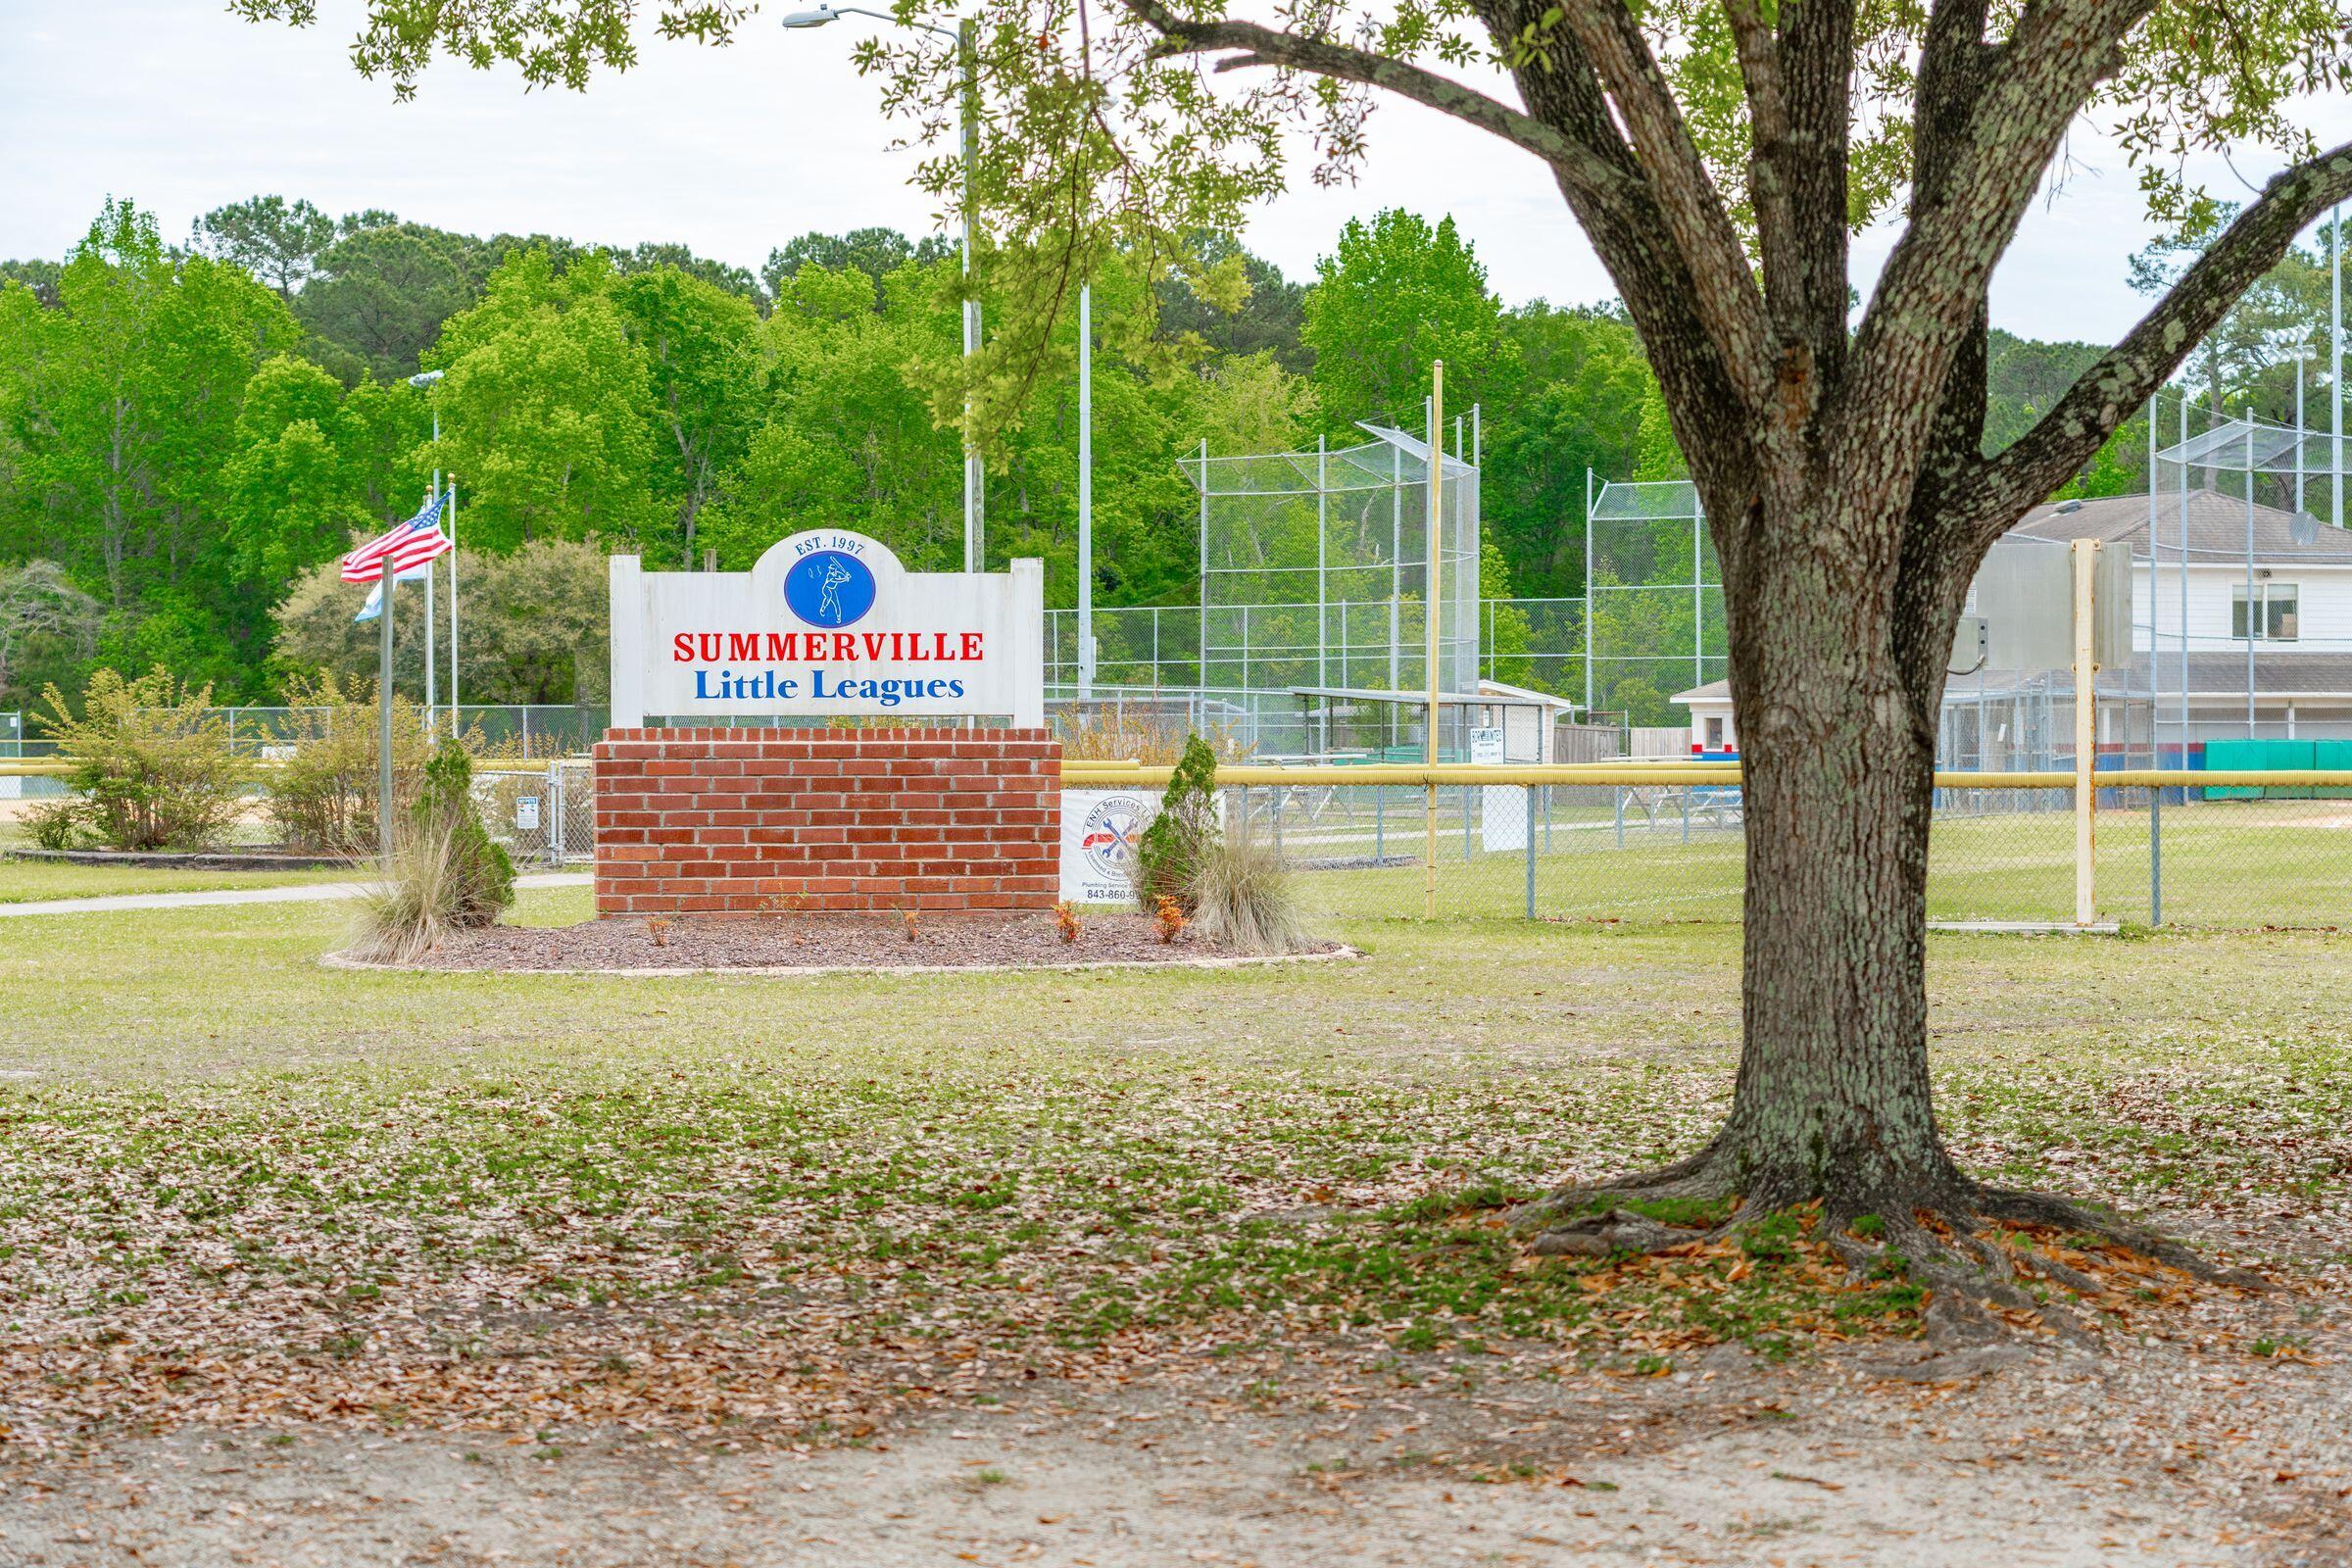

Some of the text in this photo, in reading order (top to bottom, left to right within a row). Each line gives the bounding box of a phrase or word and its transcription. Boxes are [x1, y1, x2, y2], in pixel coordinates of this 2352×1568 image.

[795, 536, 864, 556] EST. 1997
[673, 632, 984, 662] SUMMERVILLE
[694, 669, 964, 707] Little Leagues
[1087, 808, 1102, 828] ENH
[1088, 850, 1107, 873] Licensed
